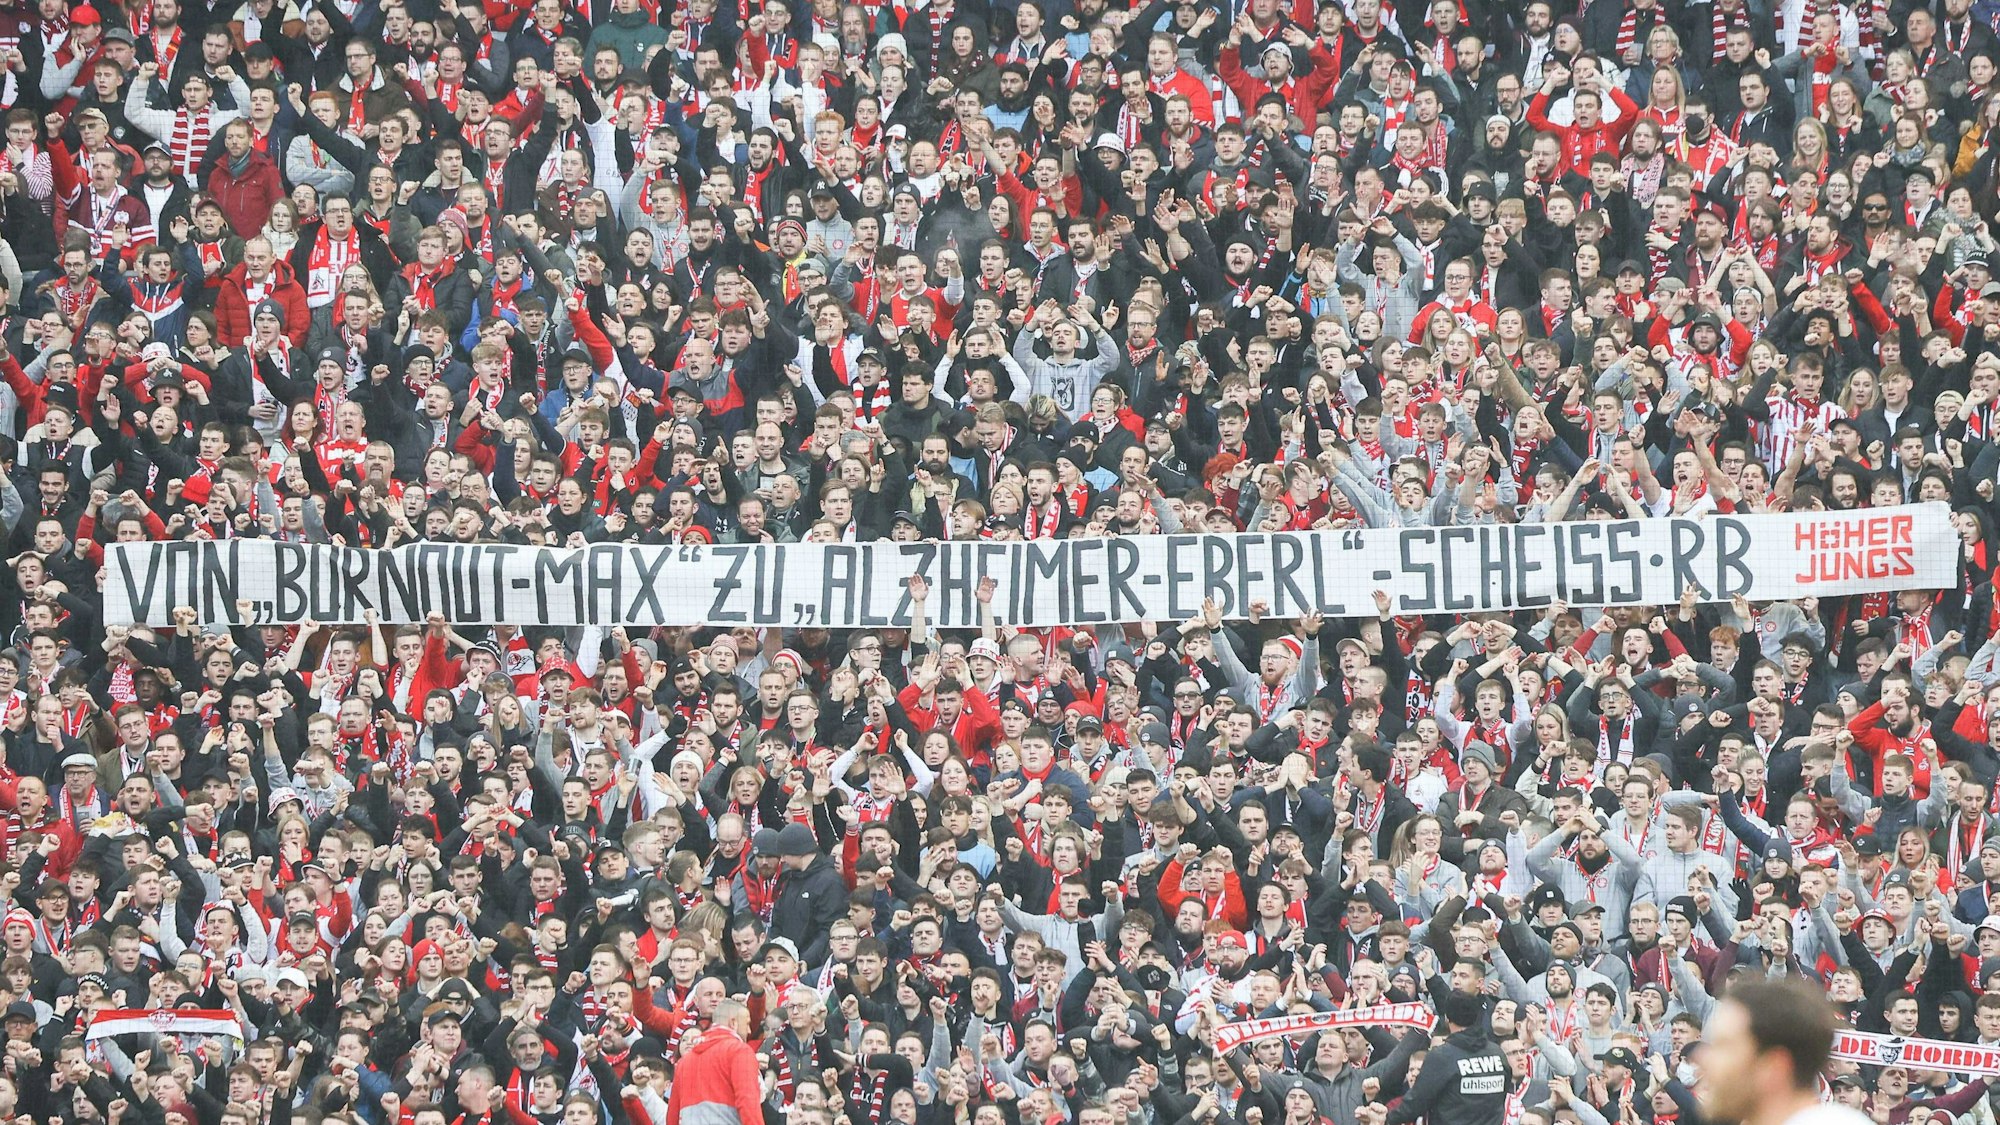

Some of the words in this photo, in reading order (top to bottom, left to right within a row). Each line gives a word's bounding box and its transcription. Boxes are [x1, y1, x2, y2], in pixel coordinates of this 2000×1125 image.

[1795, 548, 1914, 584] JUNGS
[117, 541, 239, 625] VON
[706, 545, 785, 624] ZU
[1218, 1015, 1306, 1044] WILDE
[1336, 1004, 1428, 1025] HORDE
[1457, 1055, 1504, 1076] REWE
[1903, 1044, 2000, 1069] HORDE
[1462, 1078, 1503, 1090] uhlsport
